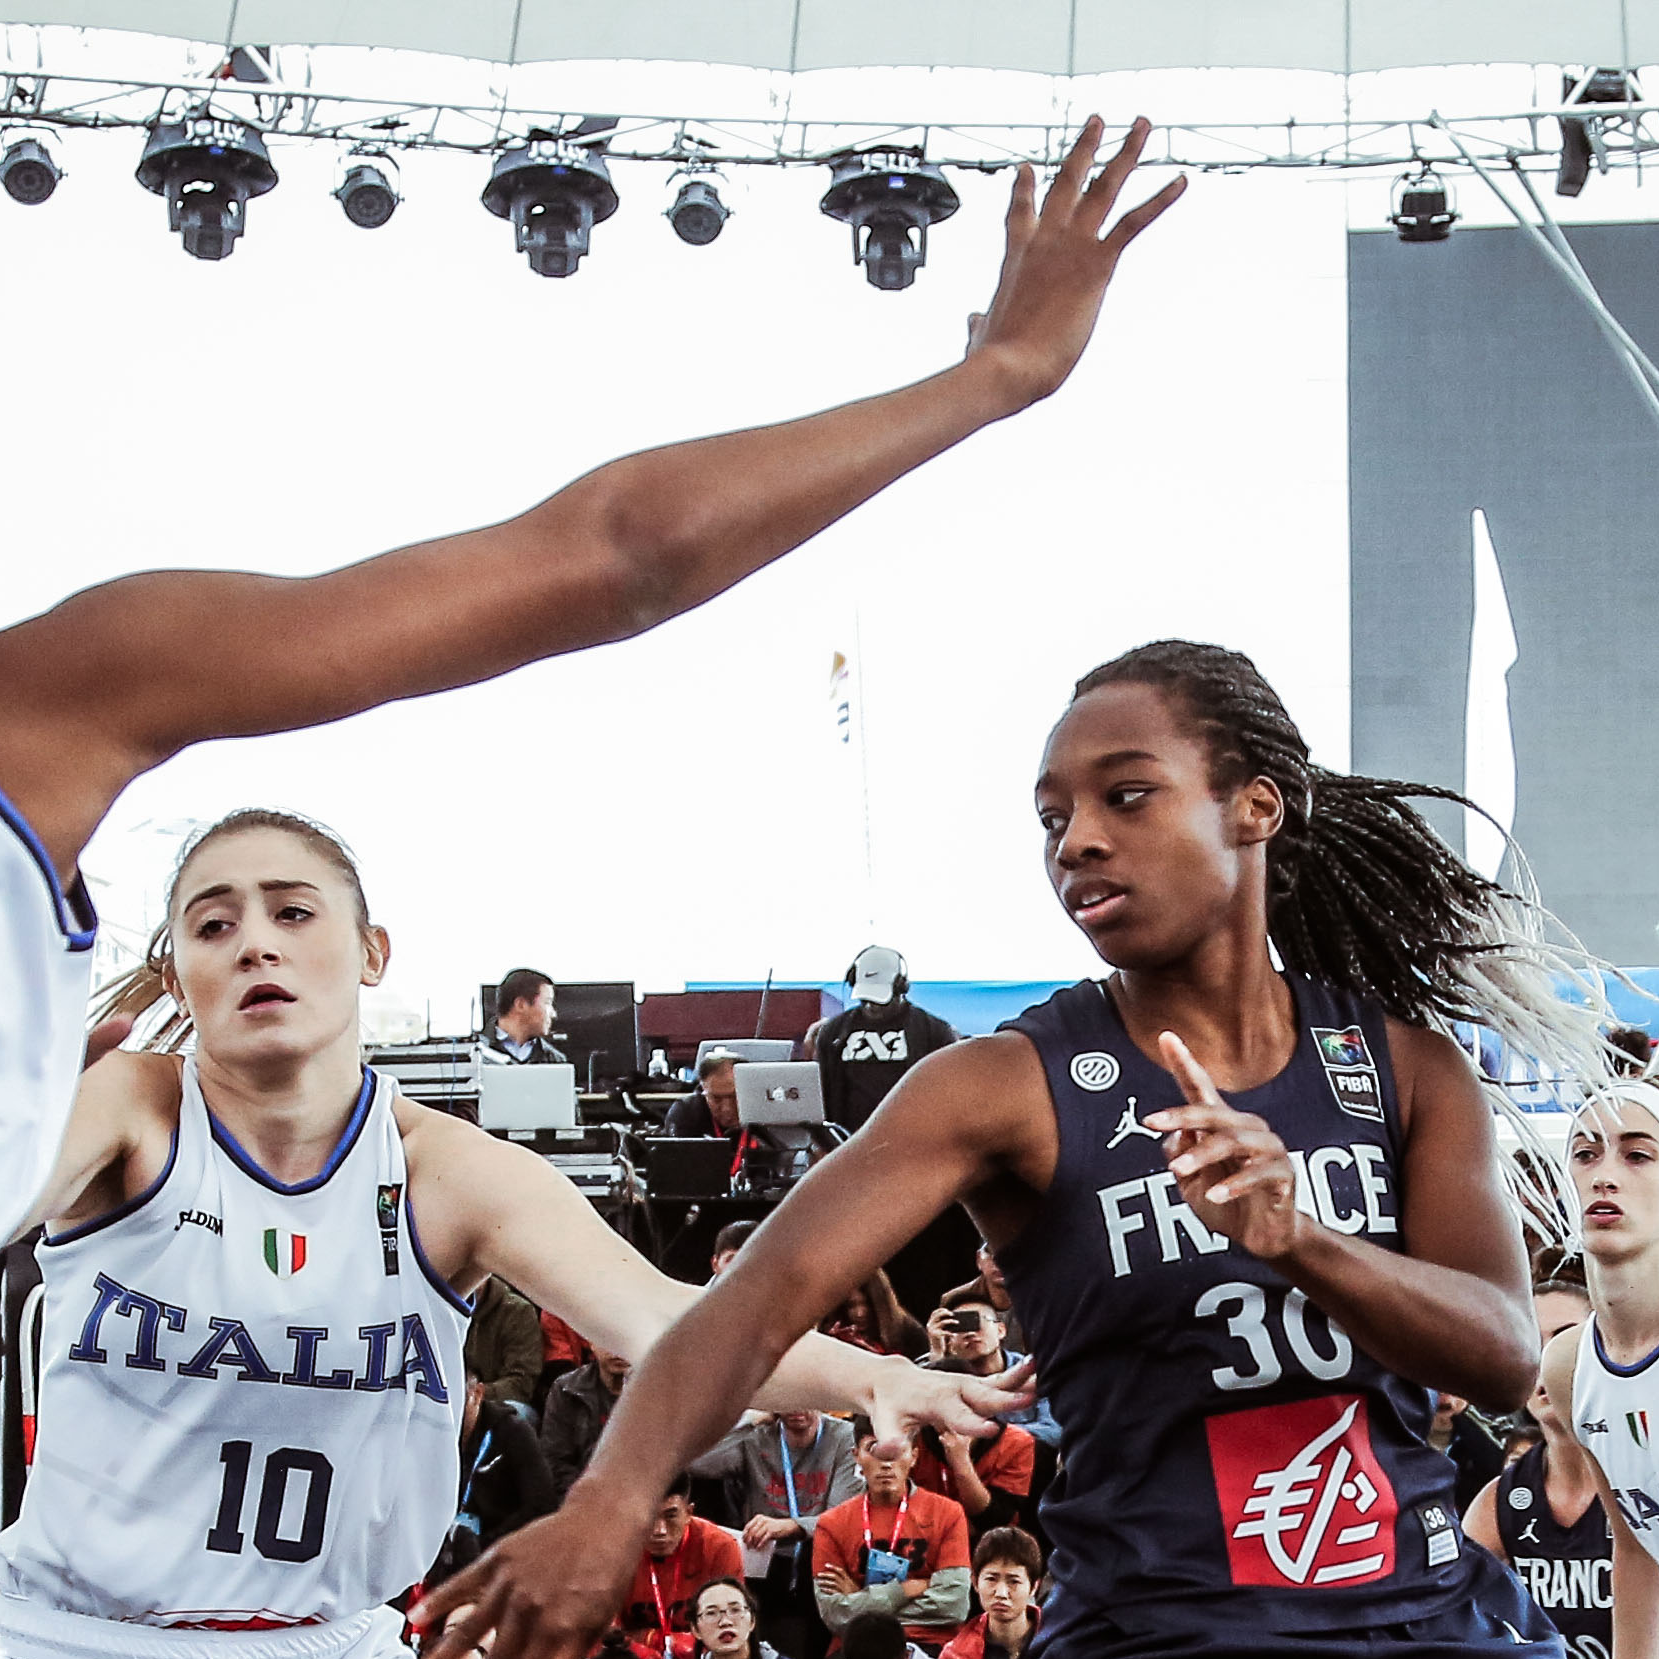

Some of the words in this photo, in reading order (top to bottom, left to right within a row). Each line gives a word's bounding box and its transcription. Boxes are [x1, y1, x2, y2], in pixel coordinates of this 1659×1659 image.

[1336, 1074, 1373, 1093] FIBA
[1096, 1143, 1397, 1277] FRCE
[69, 1271, 448, 1403] ITALIA
[1195, 1281, 1353, 1390] 30
[206, 1440, 334, 1564] 10
[1424, 1506, 1447, 1529] 38
[1514, 1556, 1613, 1609] FRANC
